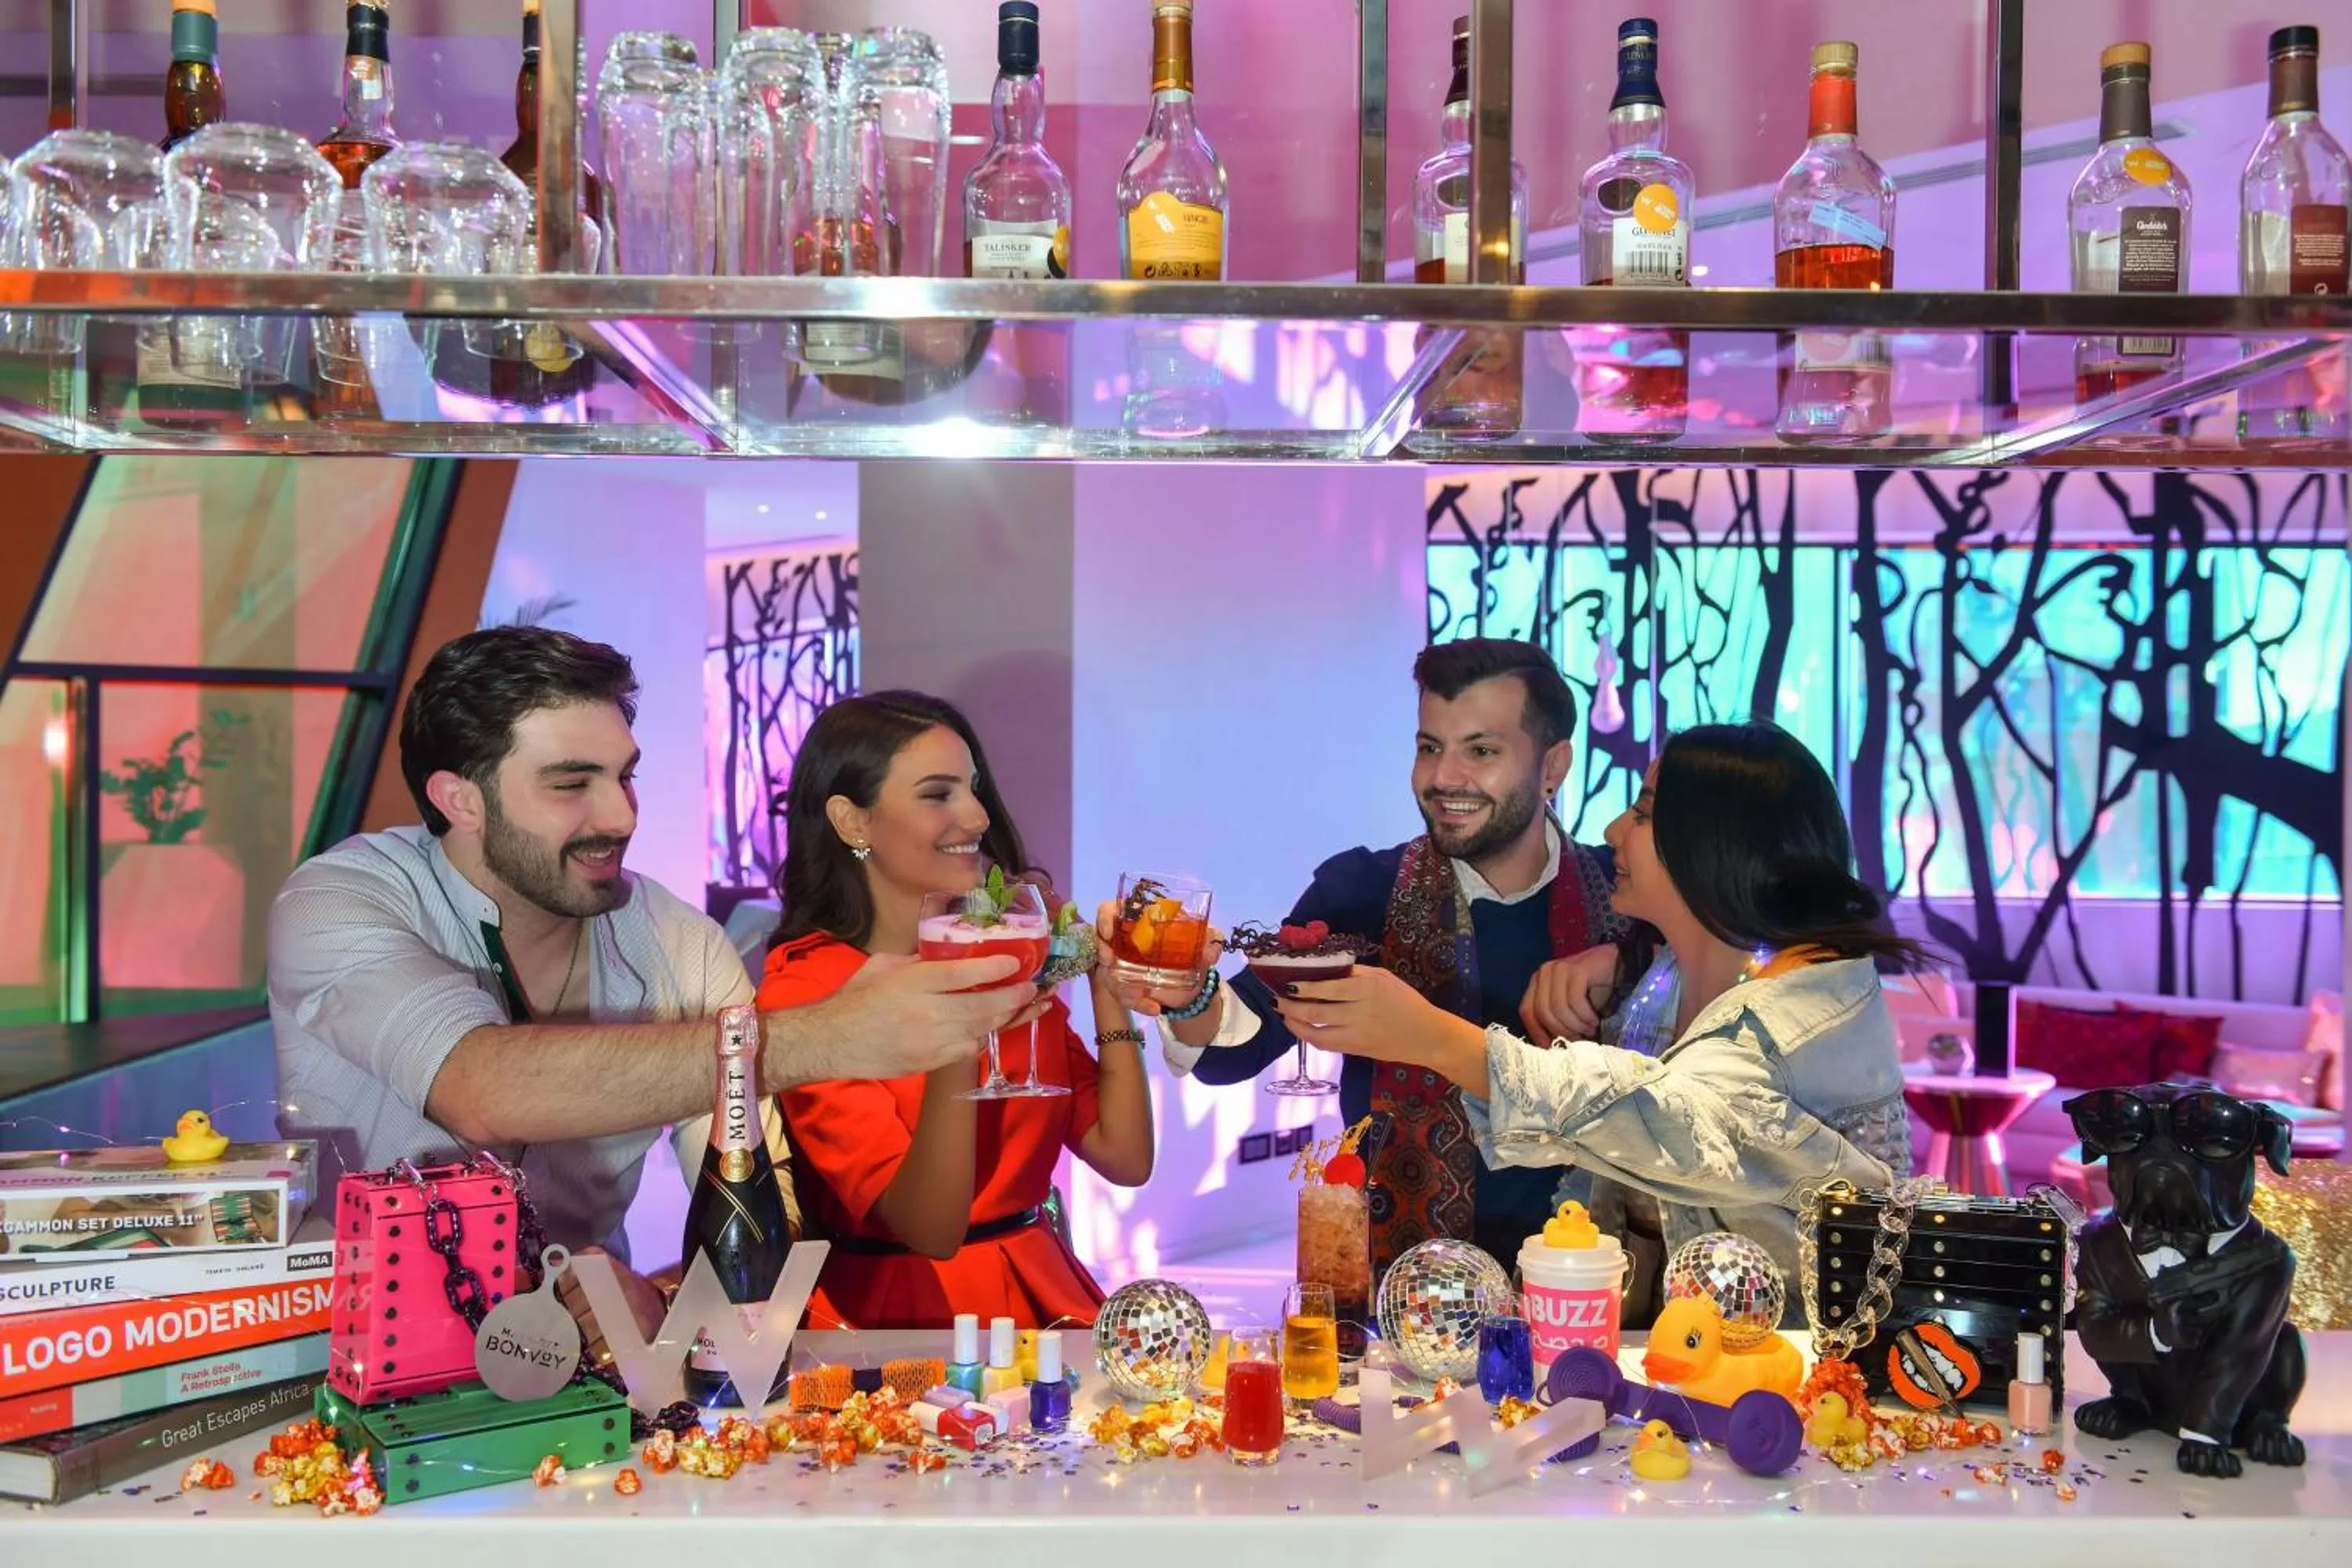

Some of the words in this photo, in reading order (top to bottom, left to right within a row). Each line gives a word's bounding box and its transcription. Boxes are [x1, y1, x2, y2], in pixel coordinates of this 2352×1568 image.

[0, 1219, 73, 1234] GAMMON
[78, 1218, 108, 1231] SET
[113, 1214, 173, 1229] DELUXE
[290, 1255, 329, 1268] MoMA
[1530, 1293, 1609, 1327] BUZZ
[3, 1326, 111, 1376] LOGO
[125, 1281, 333, 1352] MODERNISM
[162, 1421, 201, 1448] Great
[206, 1399, 266, 1431] Escapes
[270, 1383, 309, 1407] Africa
